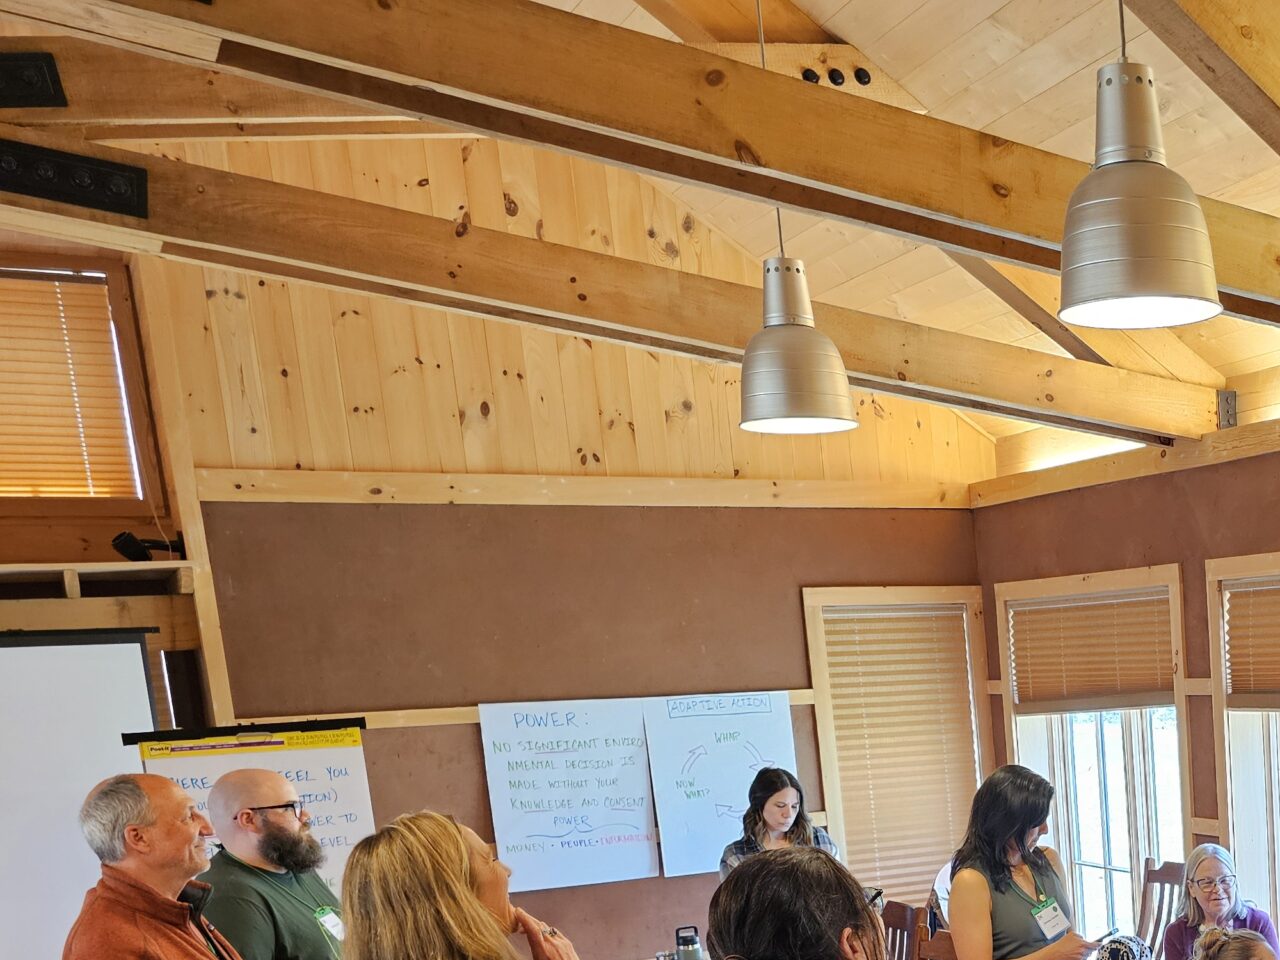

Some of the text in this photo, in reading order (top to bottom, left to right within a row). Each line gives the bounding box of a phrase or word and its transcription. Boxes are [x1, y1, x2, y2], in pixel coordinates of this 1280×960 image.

[670, 699, 726, 712] ADAPTIVE
[492, 740, 511, 754] NO
[518, 738, 600, 751] SIGNIFICANT
[565, 758, 613, 770] DECISION
[621, 756, 636, 767] IS
[326, 766, 349, 781] YOU
[508, 777, 619, 790] MADE WITHOUT YOUR
[675, 778, 696, 789] NOW
[684, 788, 710, 800] WHAT?
[510, 796, 646, 810] KNOWLEDGE AND CONSENT
[338, 812, 358, 823] TO
[553, 815, 593, 829] POWER
[506, 841, 546, 853] MONEY
[560, 839, 597, 849] PEOPLE
